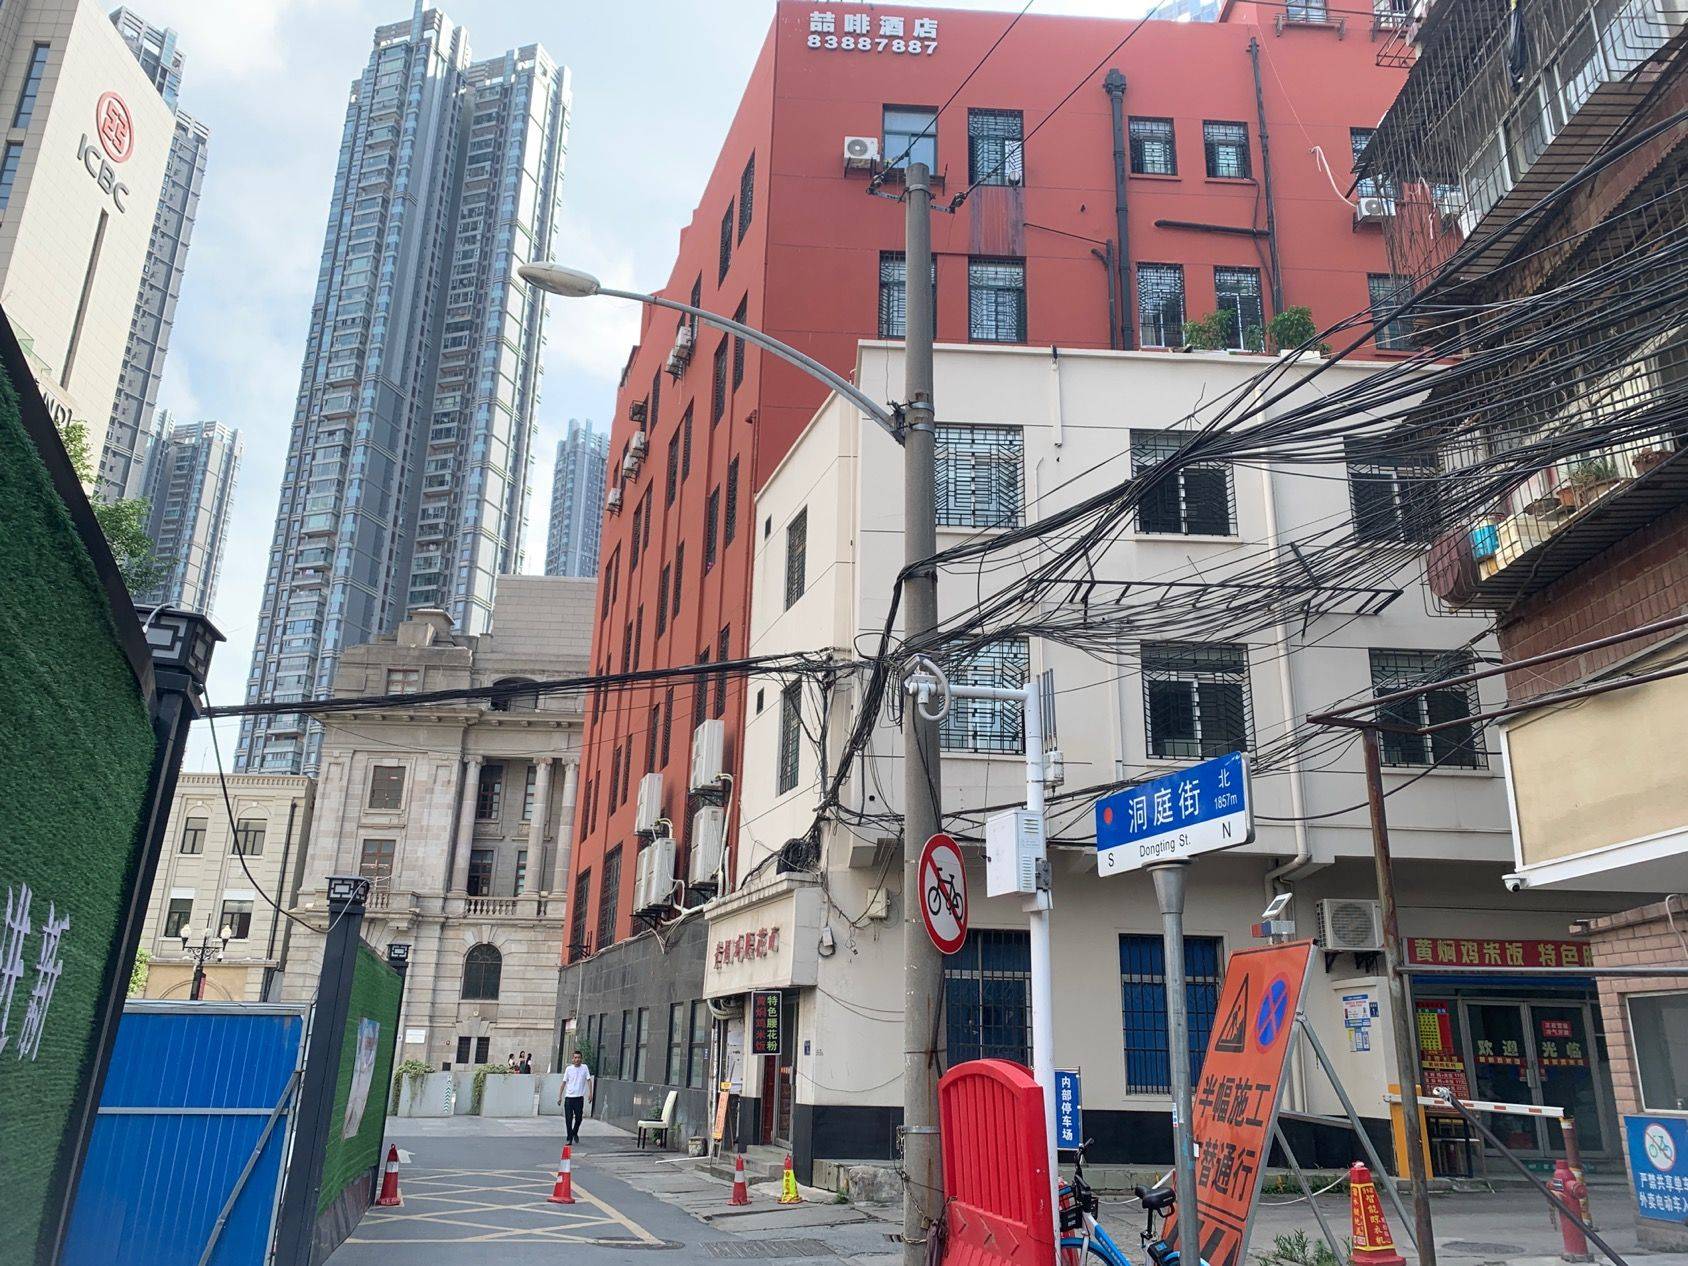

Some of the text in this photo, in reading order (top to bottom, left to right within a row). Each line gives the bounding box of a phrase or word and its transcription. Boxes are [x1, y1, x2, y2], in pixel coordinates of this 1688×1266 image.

[807, 34, 938, 55] 83887887
[77, 133, 129, 214] ICBC
[1128, 769, 1231, 834] 洞庭街 北
[1108, 821, 1232, 867] S Dongting St. N
[767, 995, 778, 1052] 特色腰花粉
[1061, 1075, 1073, 1141] 内部停车场
[1199, 1074, 1271, 1127] 半幅施工
